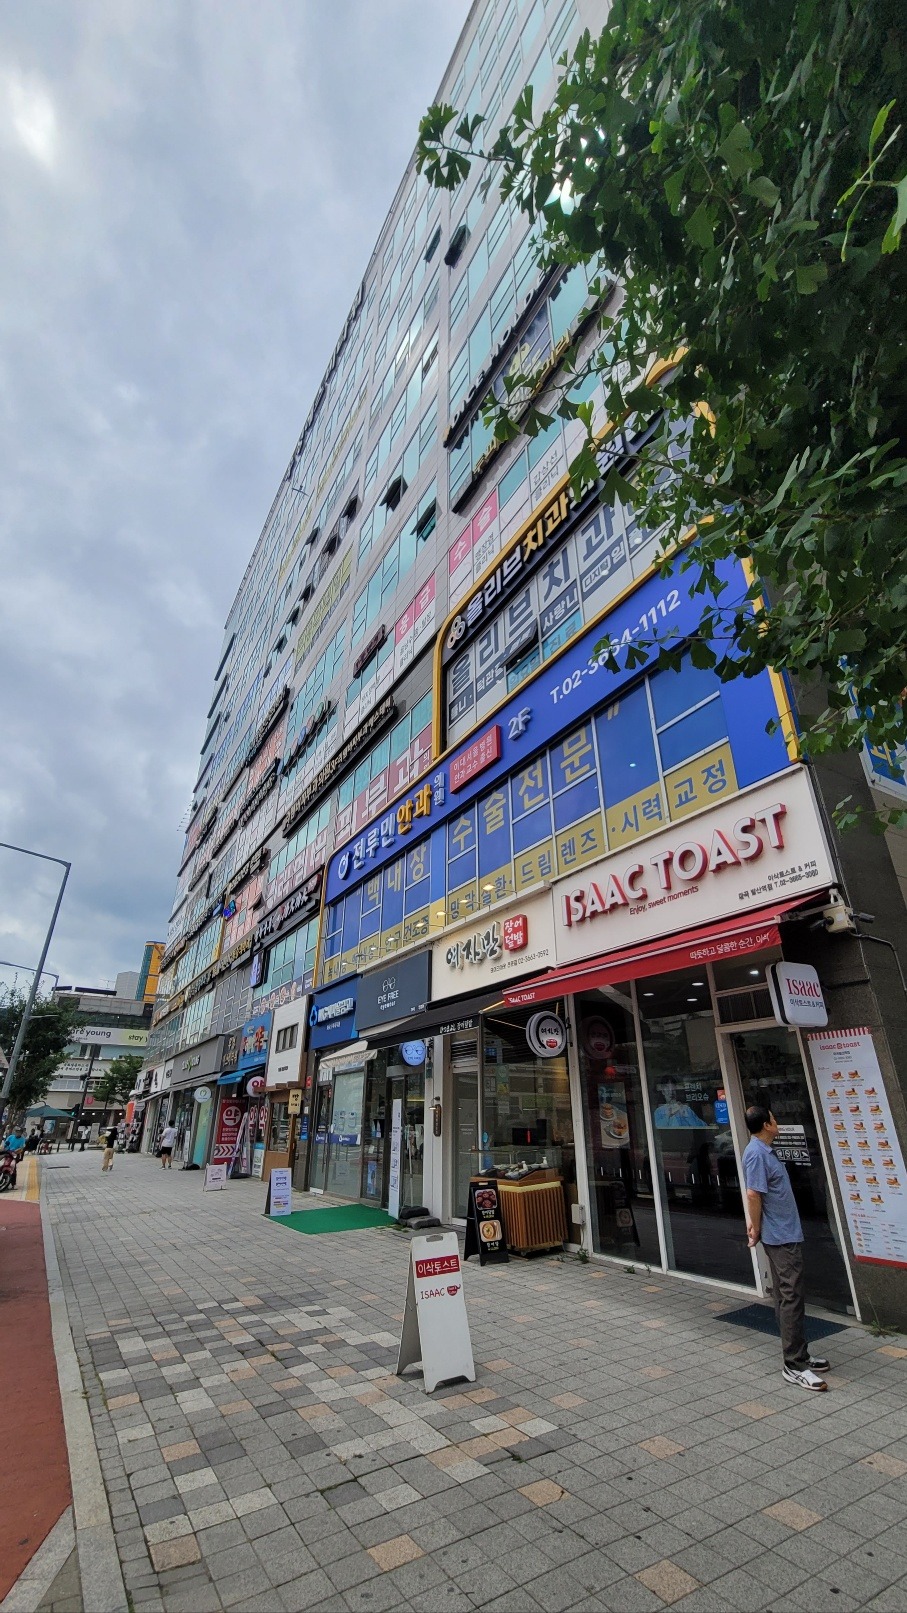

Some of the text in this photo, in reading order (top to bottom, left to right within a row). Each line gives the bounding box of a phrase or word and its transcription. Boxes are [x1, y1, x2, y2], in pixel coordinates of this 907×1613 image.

[507, 707, 532, 741] 2F
[561, 803, 787, 927] ISAAC TOAST
[629, 884, 699, 916] Enjoy, sweet moments
[504, 917, 523, 933] 장어
[504, 932, 524, 949] 덮밥
[377, 990, 399, 1005] EYE FREE
[521, 992, 536, 1002] TOAST
[85, 1029, 112, 1038] young
[127, 1033, 144, 1042] stay
[225, 1108, 240, 1124] 약
[417, 1257, 460, 1276] 이삭토스트
[420, 1286, 446, 1301] ISAAC
